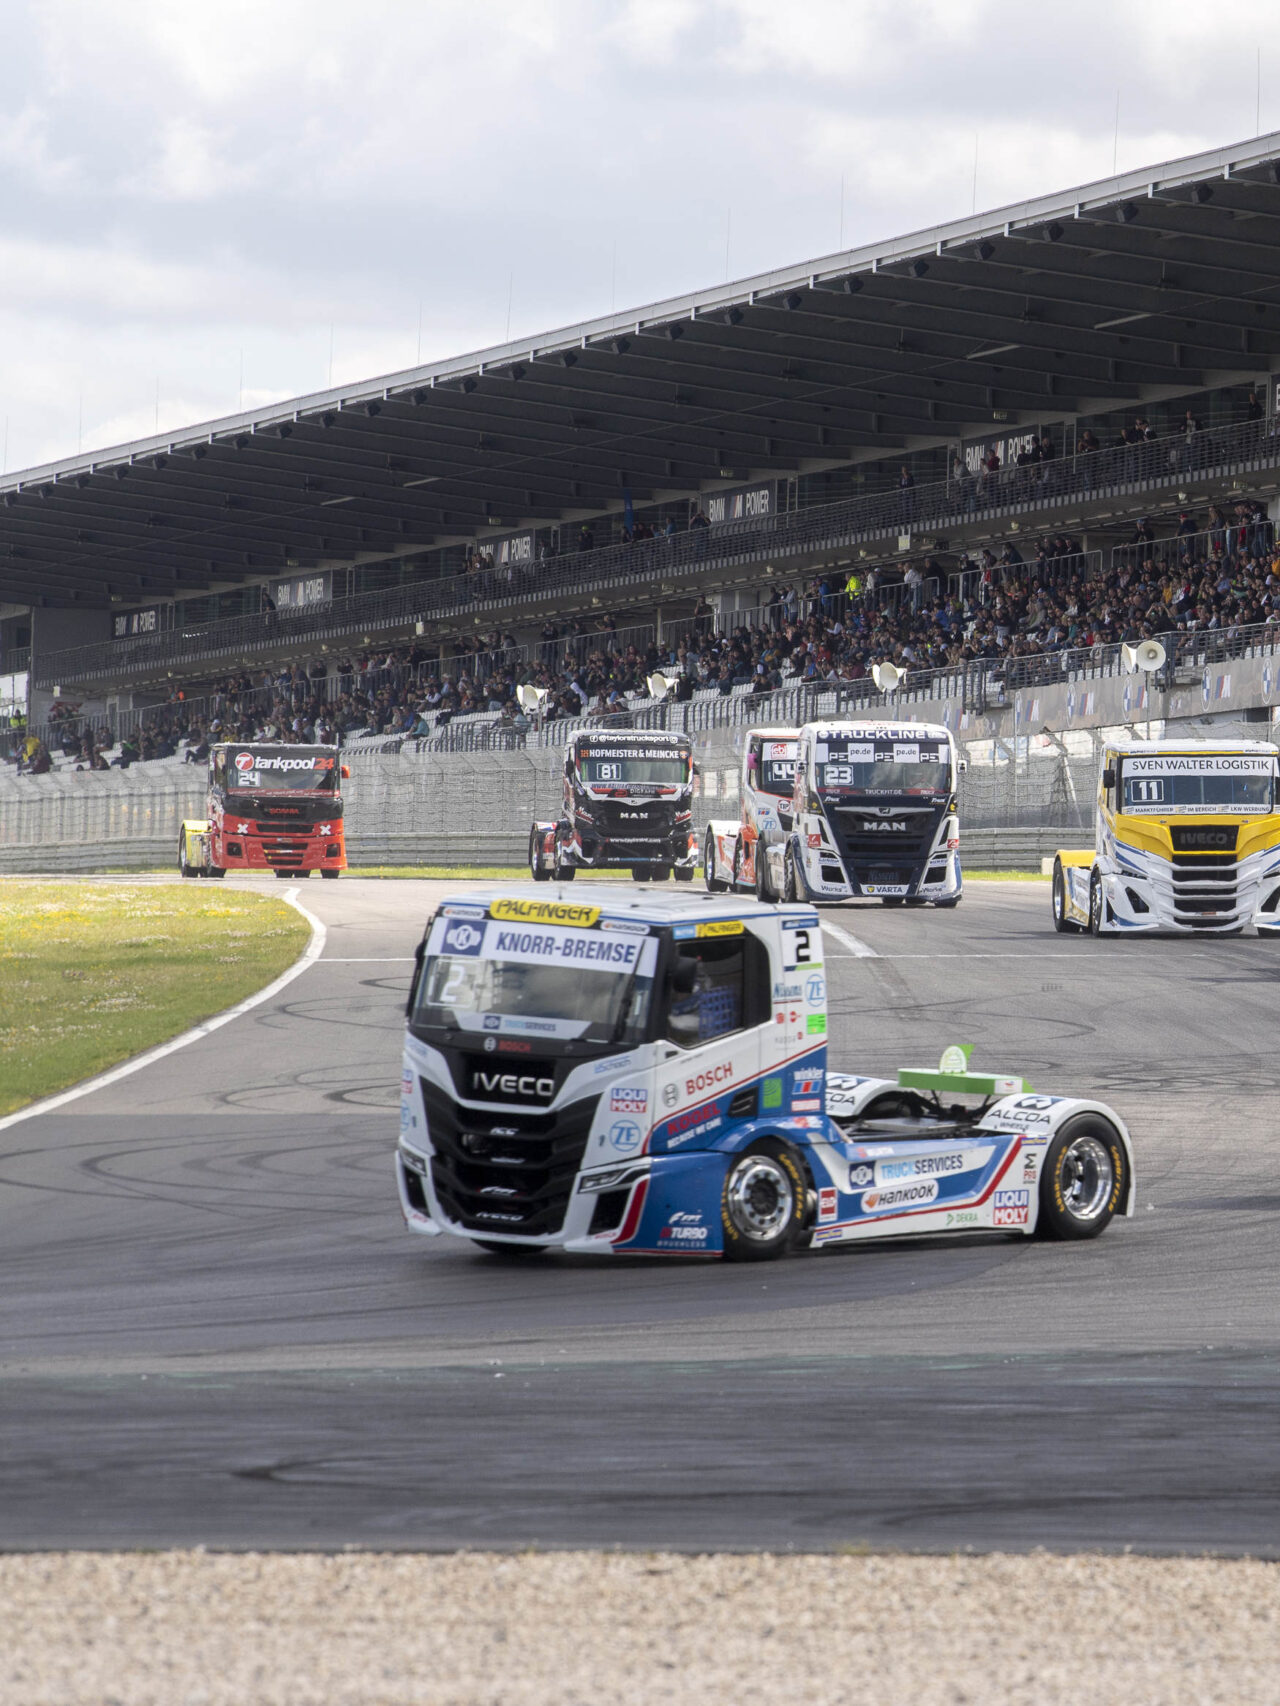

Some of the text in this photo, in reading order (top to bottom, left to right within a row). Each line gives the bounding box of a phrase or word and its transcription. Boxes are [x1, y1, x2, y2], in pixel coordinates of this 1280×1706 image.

[709, 498, 725, 521] BMW
[746, 489, 769, 516] POWER
[829, 731, 926, 739] TRUCKLINE
[589, 749, 679, 759] HOFMEISTER & MEINCKE
[850, 748, 872, 756] pe.de
[601, 764, 617, 779] 81
[1132, 759, 1269, 770] SVEN WALTER LOGISTIK
[239, 771, 260, 786] 24
[825, 766, 852, 784] 23
[1139, 781, 1158, 800] 11
[863, 822, 907, 831] MAN
[1180, 832, 1228, 845] IVECO
[496, 899, 594, 922] PALFINGER
[496, 931, 636, 963] KNORR-BREMSE
[795, 930, 811, 963] 2
[440, 965, 464, 1002] 2
[473, 1072, 555, 1096] IVECO
[685, 1061, 733, 1095] BOSCH
[612, 1088, 647, 1101] LIQUI
[611, 1101, 647, 1113] MOLY
[987, 1109, 1050, 1124] ALCOA
[995, 1191, 1029, 1207] LIQUI
[994, 1208, 1029, 1224] MOLY
